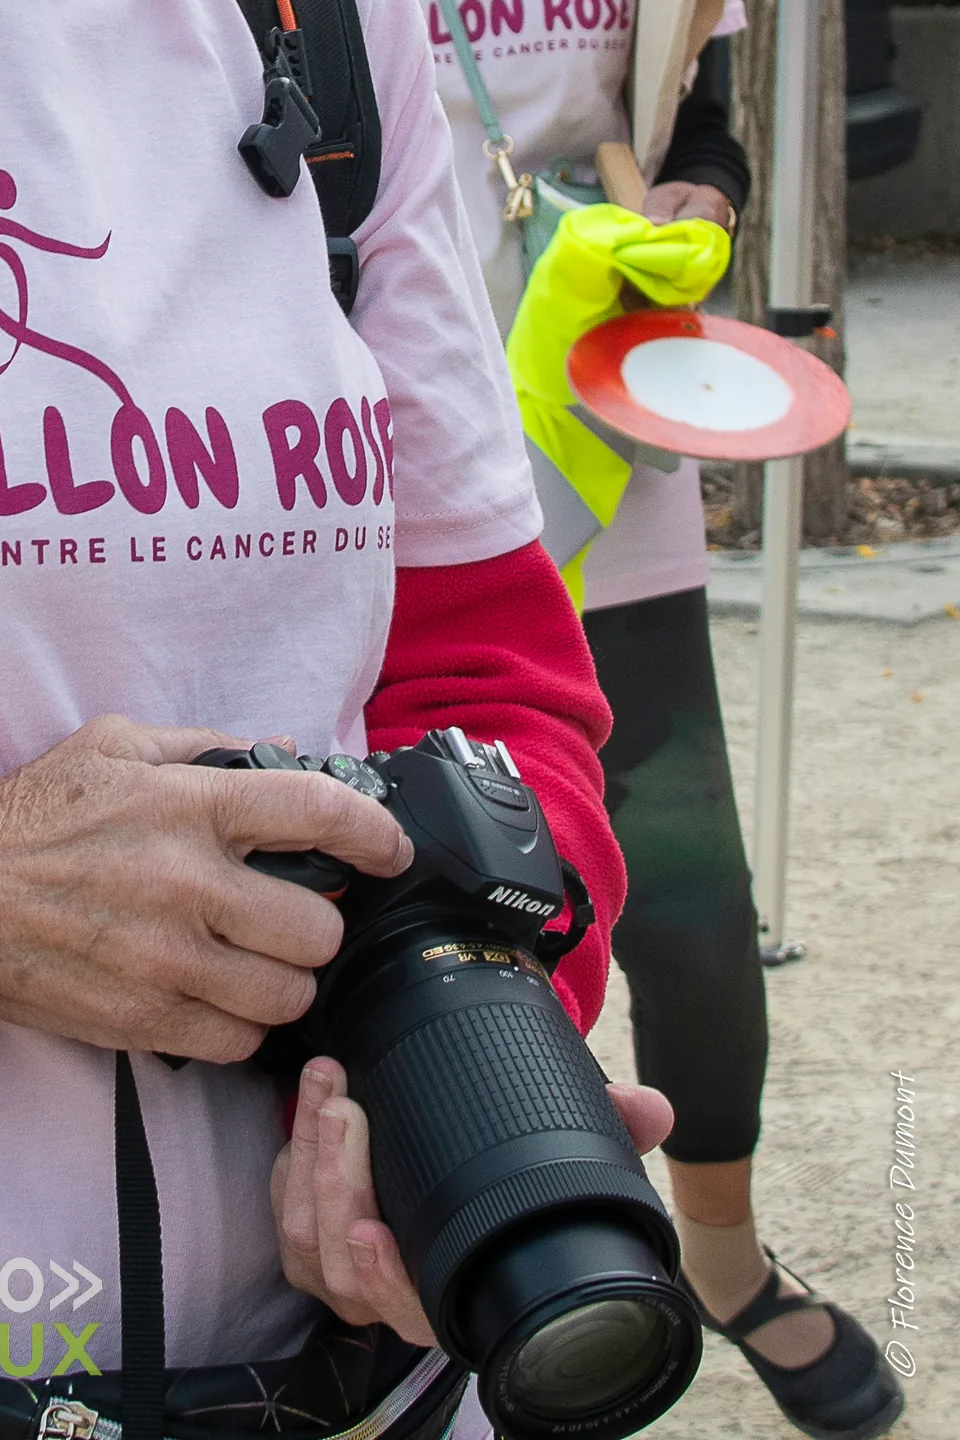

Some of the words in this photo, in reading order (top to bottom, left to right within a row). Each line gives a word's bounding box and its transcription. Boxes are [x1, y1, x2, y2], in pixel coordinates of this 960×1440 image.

[493, 38, 569, 58] CANCER
[130, 536, 167, 562] LE
[187, 530, 318, 561] CANCER
[335, 526, 367, 553] DU
[487, 885, 556, 916] Nikon
